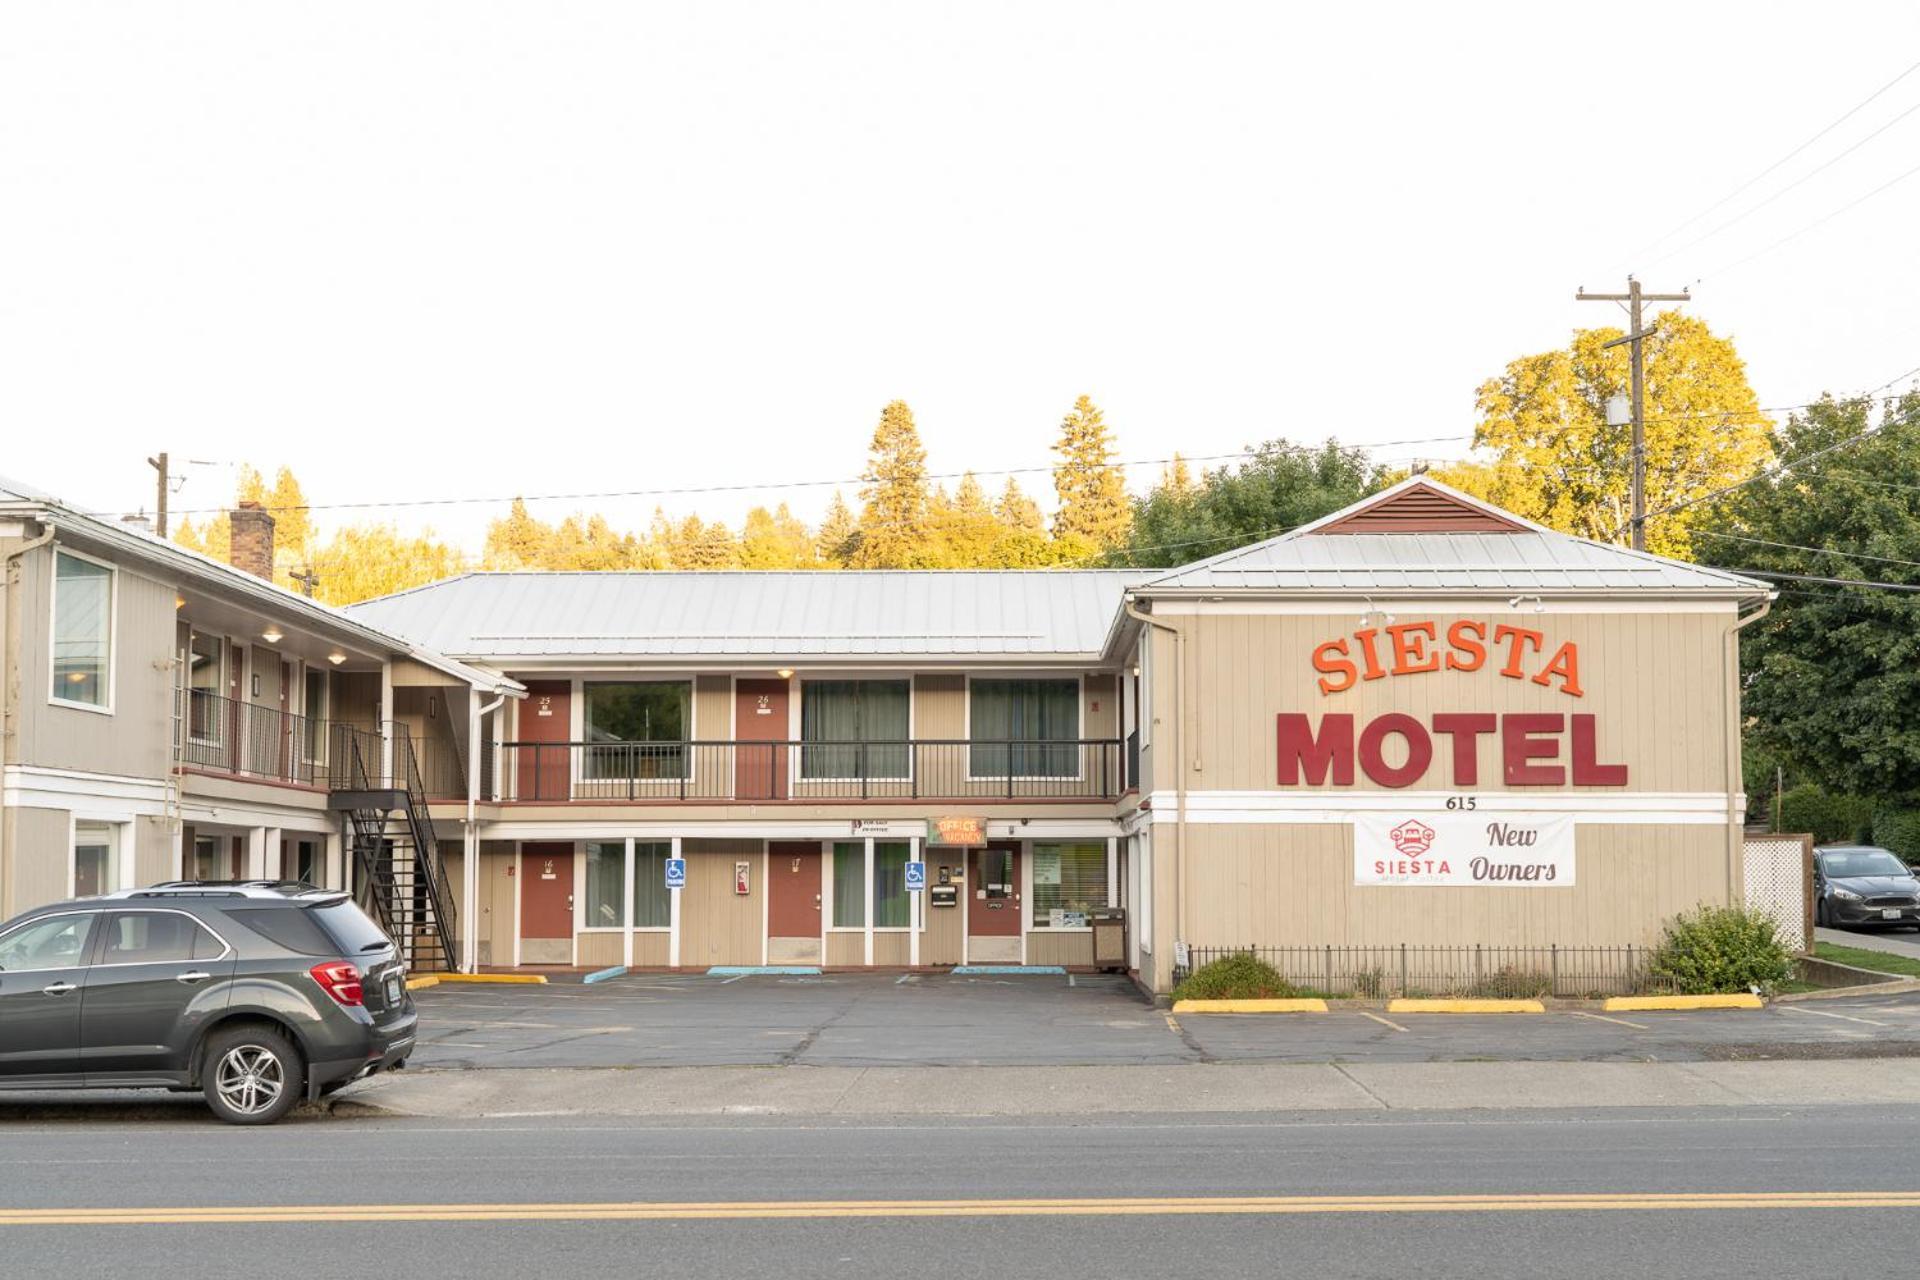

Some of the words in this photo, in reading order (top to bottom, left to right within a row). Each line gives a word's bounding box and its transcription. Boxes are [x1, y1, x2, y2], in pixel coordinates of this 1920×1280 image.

[1312, 619, 1585, 697] SIESTA
[1277, 712, 1628, 788] MOTEL
[1446, 796, 1476, 811] 615
[938, 819, 977, 832] OFFICE
[1486, 822, 1538, 847] New
[943, 832, 982, 843] VACANCY
[1375, 859, 1451, 874] SIESTA
[1469, 856, 1556, 881] Owners
